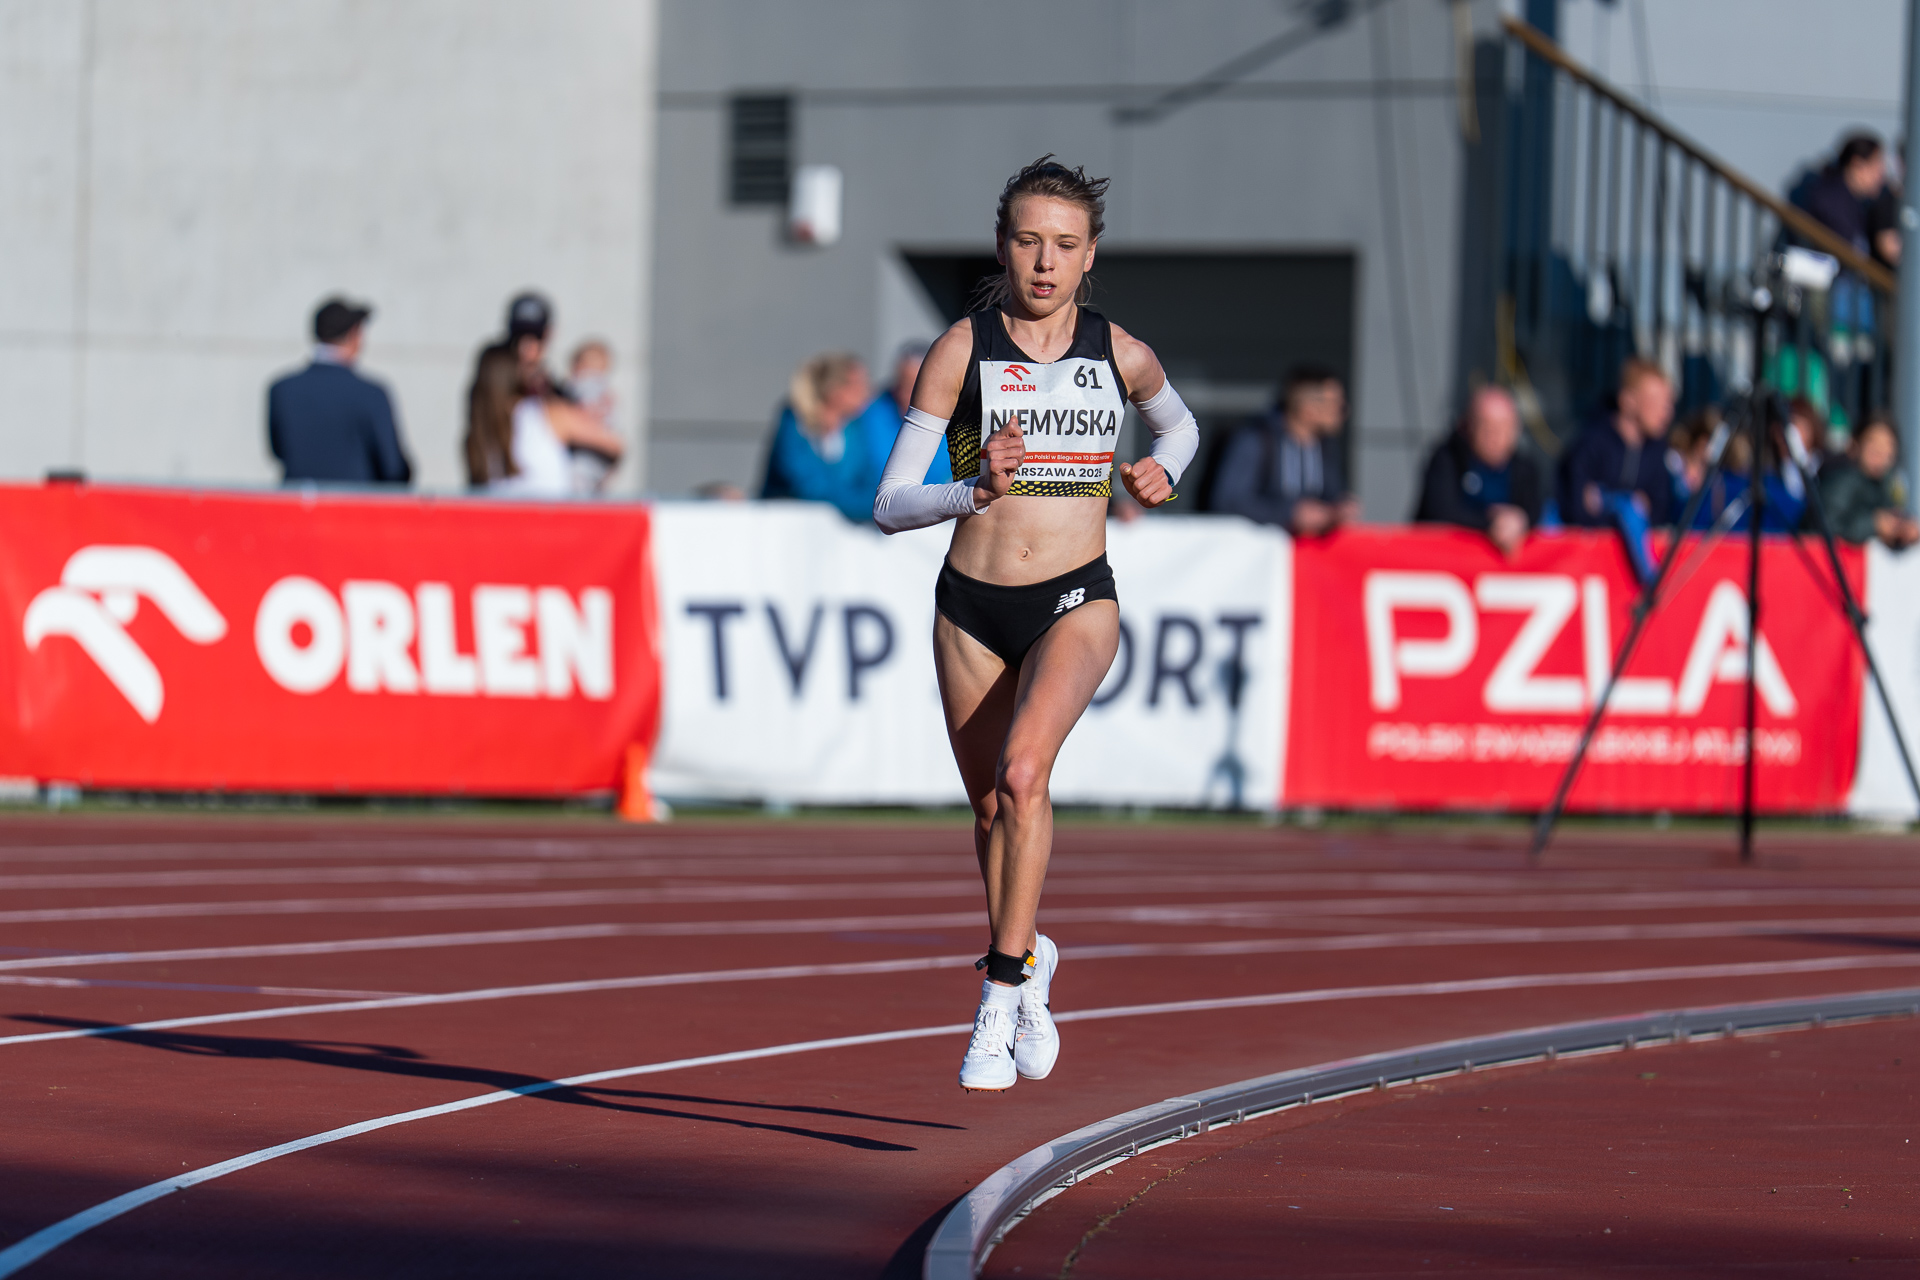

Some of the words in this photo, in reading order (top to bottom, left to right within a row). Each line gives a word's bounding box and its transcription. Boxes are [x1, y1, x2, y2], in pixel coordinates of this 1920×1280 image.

[1000, 384, 1037, 392] ORLEN
[1073, 365, 1103, 390] 61
[1014, 467, 1077, 478] ARSZAWA
[1079, 468, 1103, 478] 2025
[256, 575, 615, 699] ORLEN
[684, 602, 898, 703] TVP
[1088, 611, 1263, 710] ORT
[1364, 570, 1797, 718] PZLA
